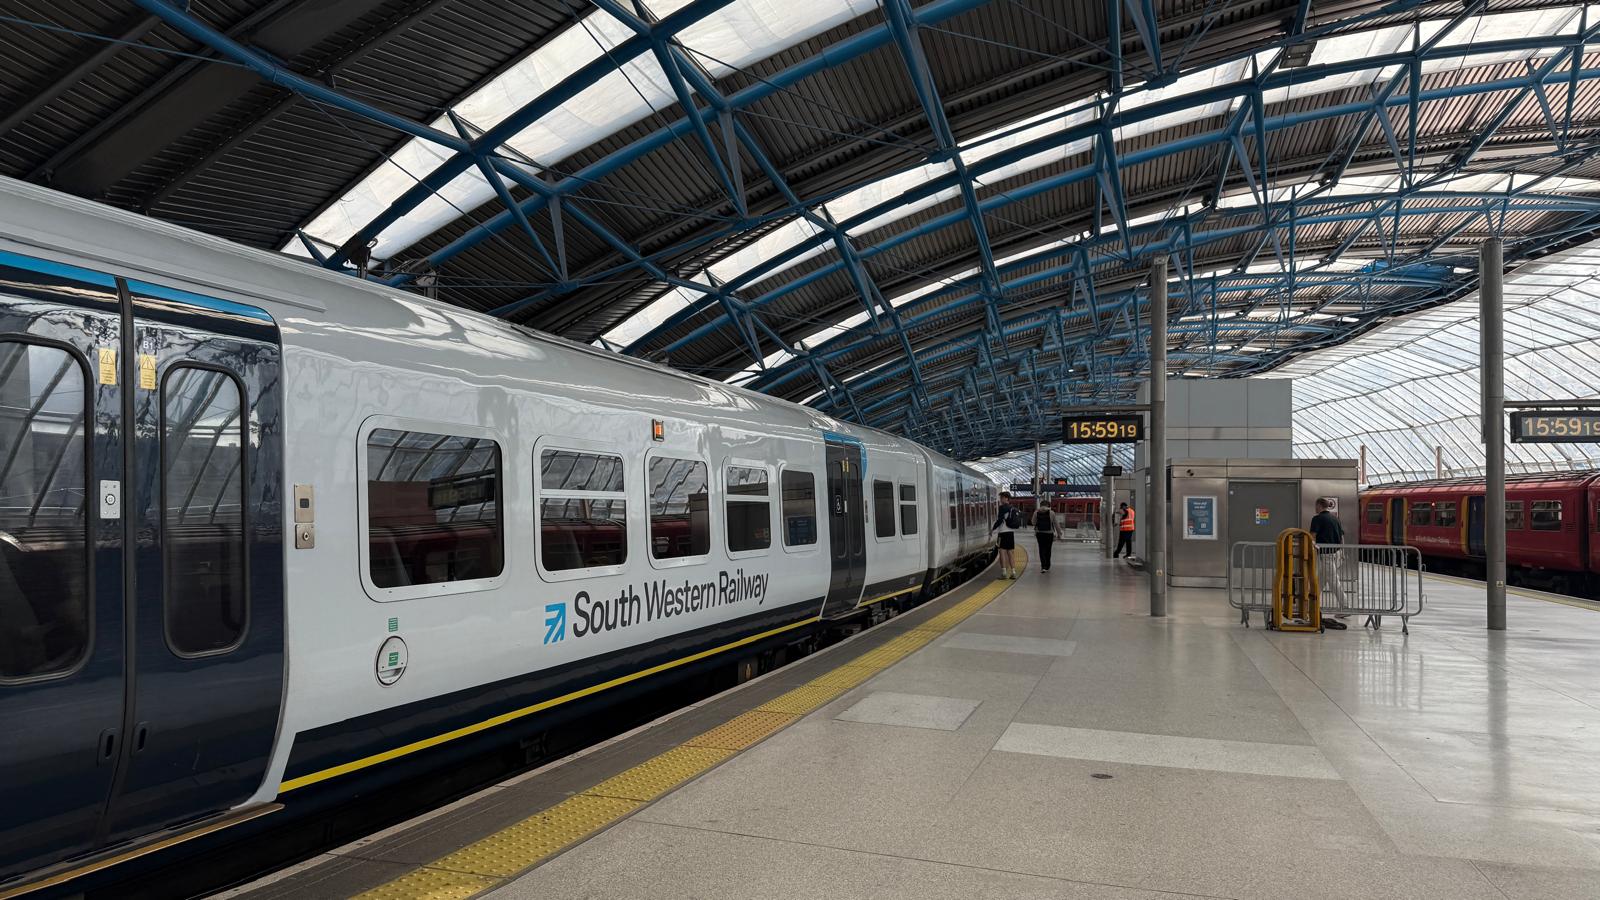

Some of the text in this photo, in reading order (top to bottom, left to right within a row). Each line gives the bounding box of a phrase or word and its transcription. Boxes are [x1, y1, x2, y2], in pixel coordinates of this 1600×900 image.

[143, 340, 153, 350] B1
[1070, 421, 1137, 438] 15:59 19
[1525, 416, 1582, 436] 15:59
[573, 568, 769, 638] South Western Railway
